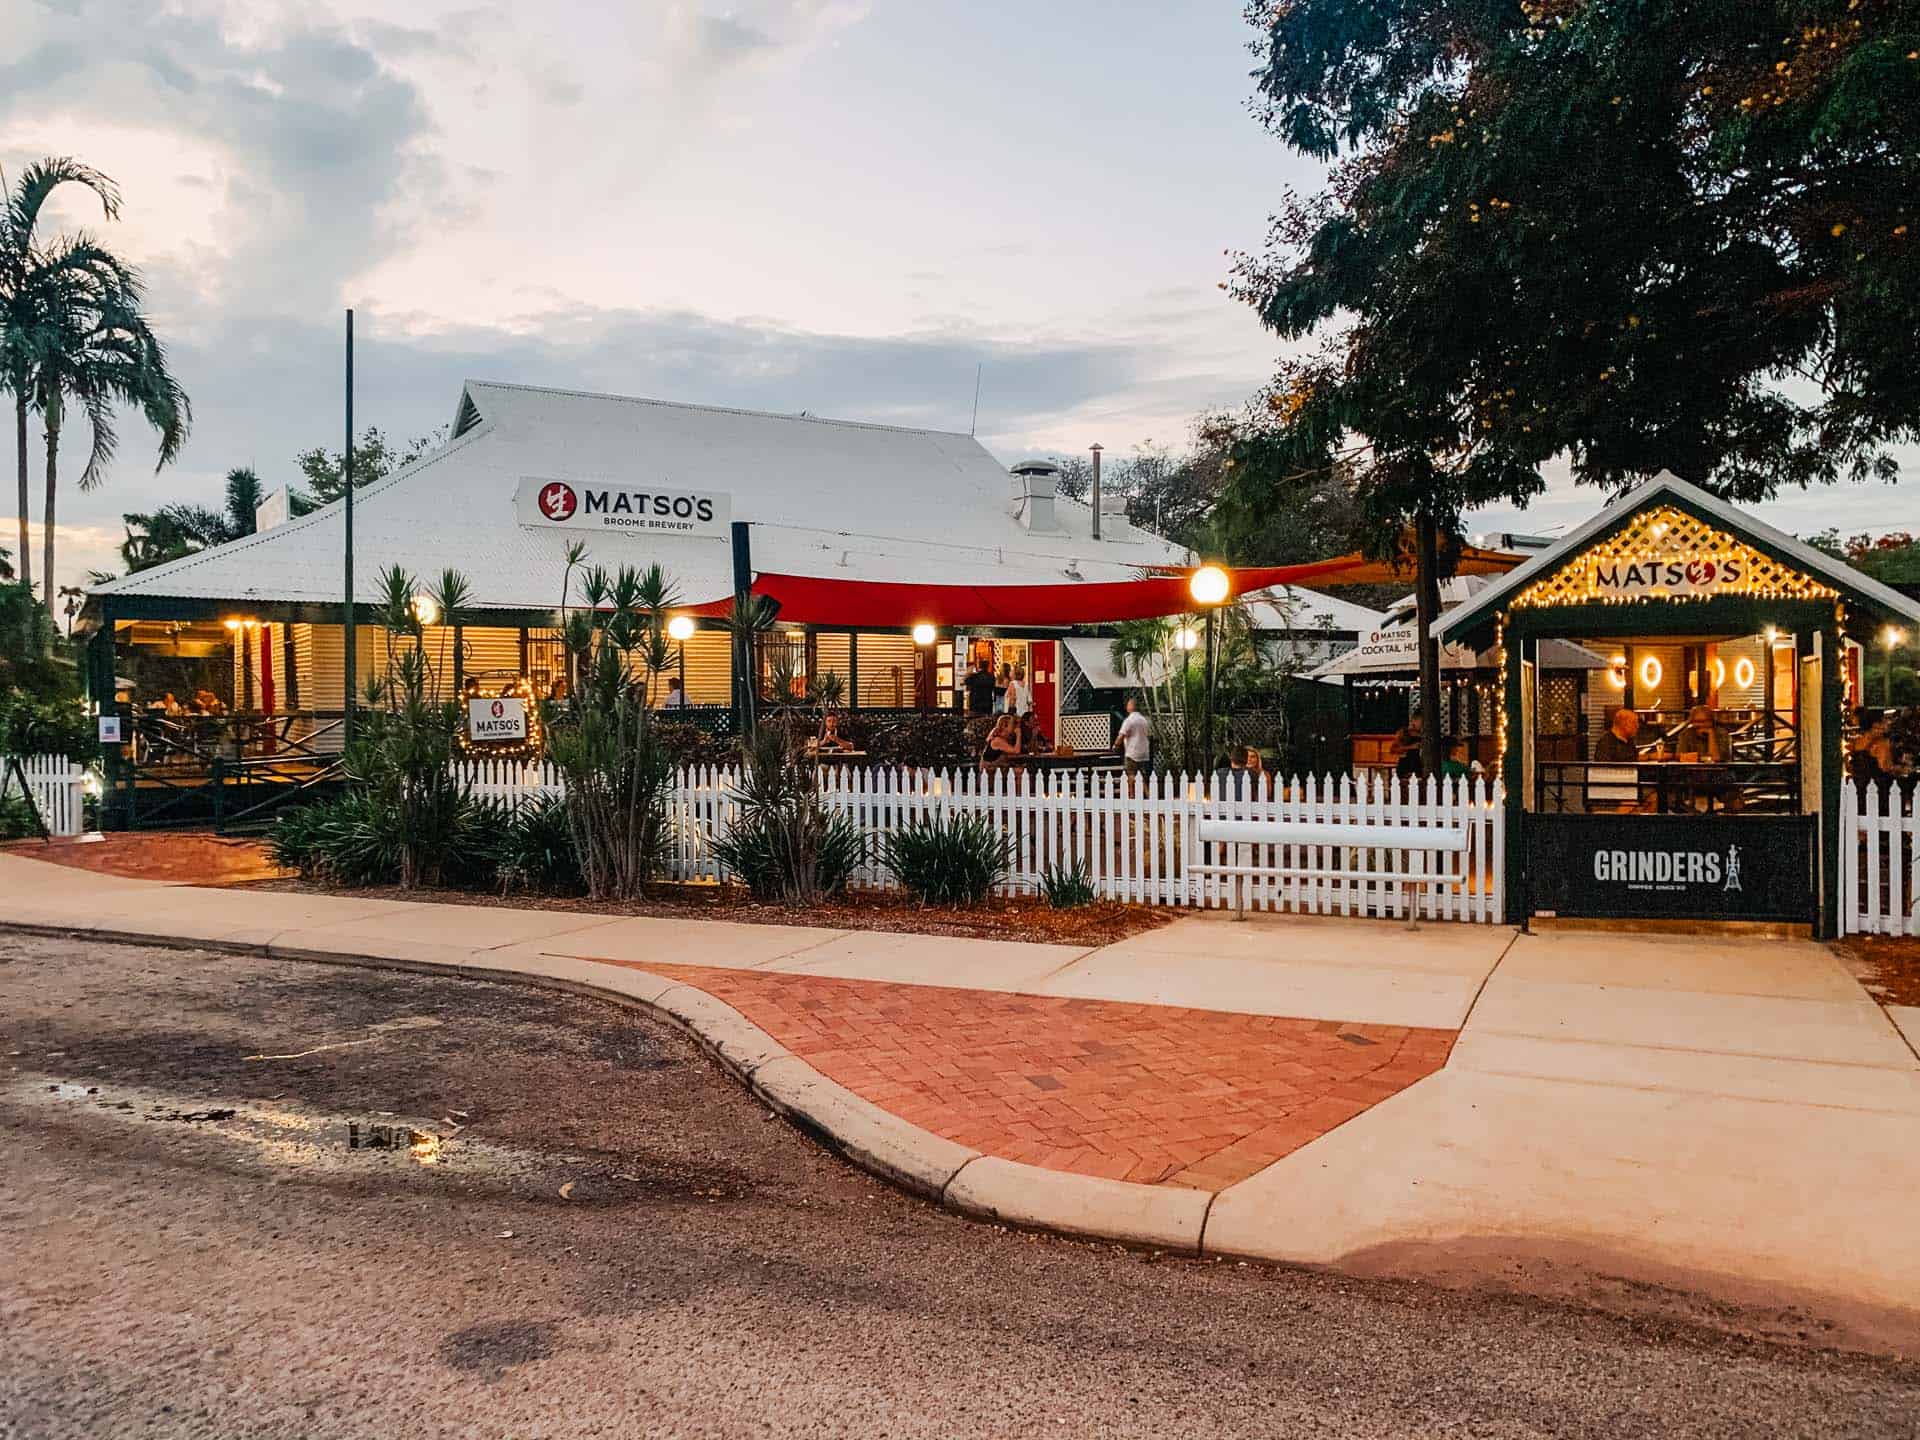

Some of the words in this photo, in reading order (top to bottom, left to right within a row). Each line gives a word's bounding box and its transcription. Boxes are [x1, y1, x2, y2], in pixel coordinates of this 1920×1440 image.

[584, 489, 713, 522] MATSO'S
[603, 516, 646, 528] BROOME
[648, 518, 695, 530] BREWERY
[1362, 645, 1401, 654] COCKTAIL
[1404, 642, 1420, 652] HU
[476, 720, 519, 732] MATSO'S
[1594, 850, 1721, 883] GRINDERS
